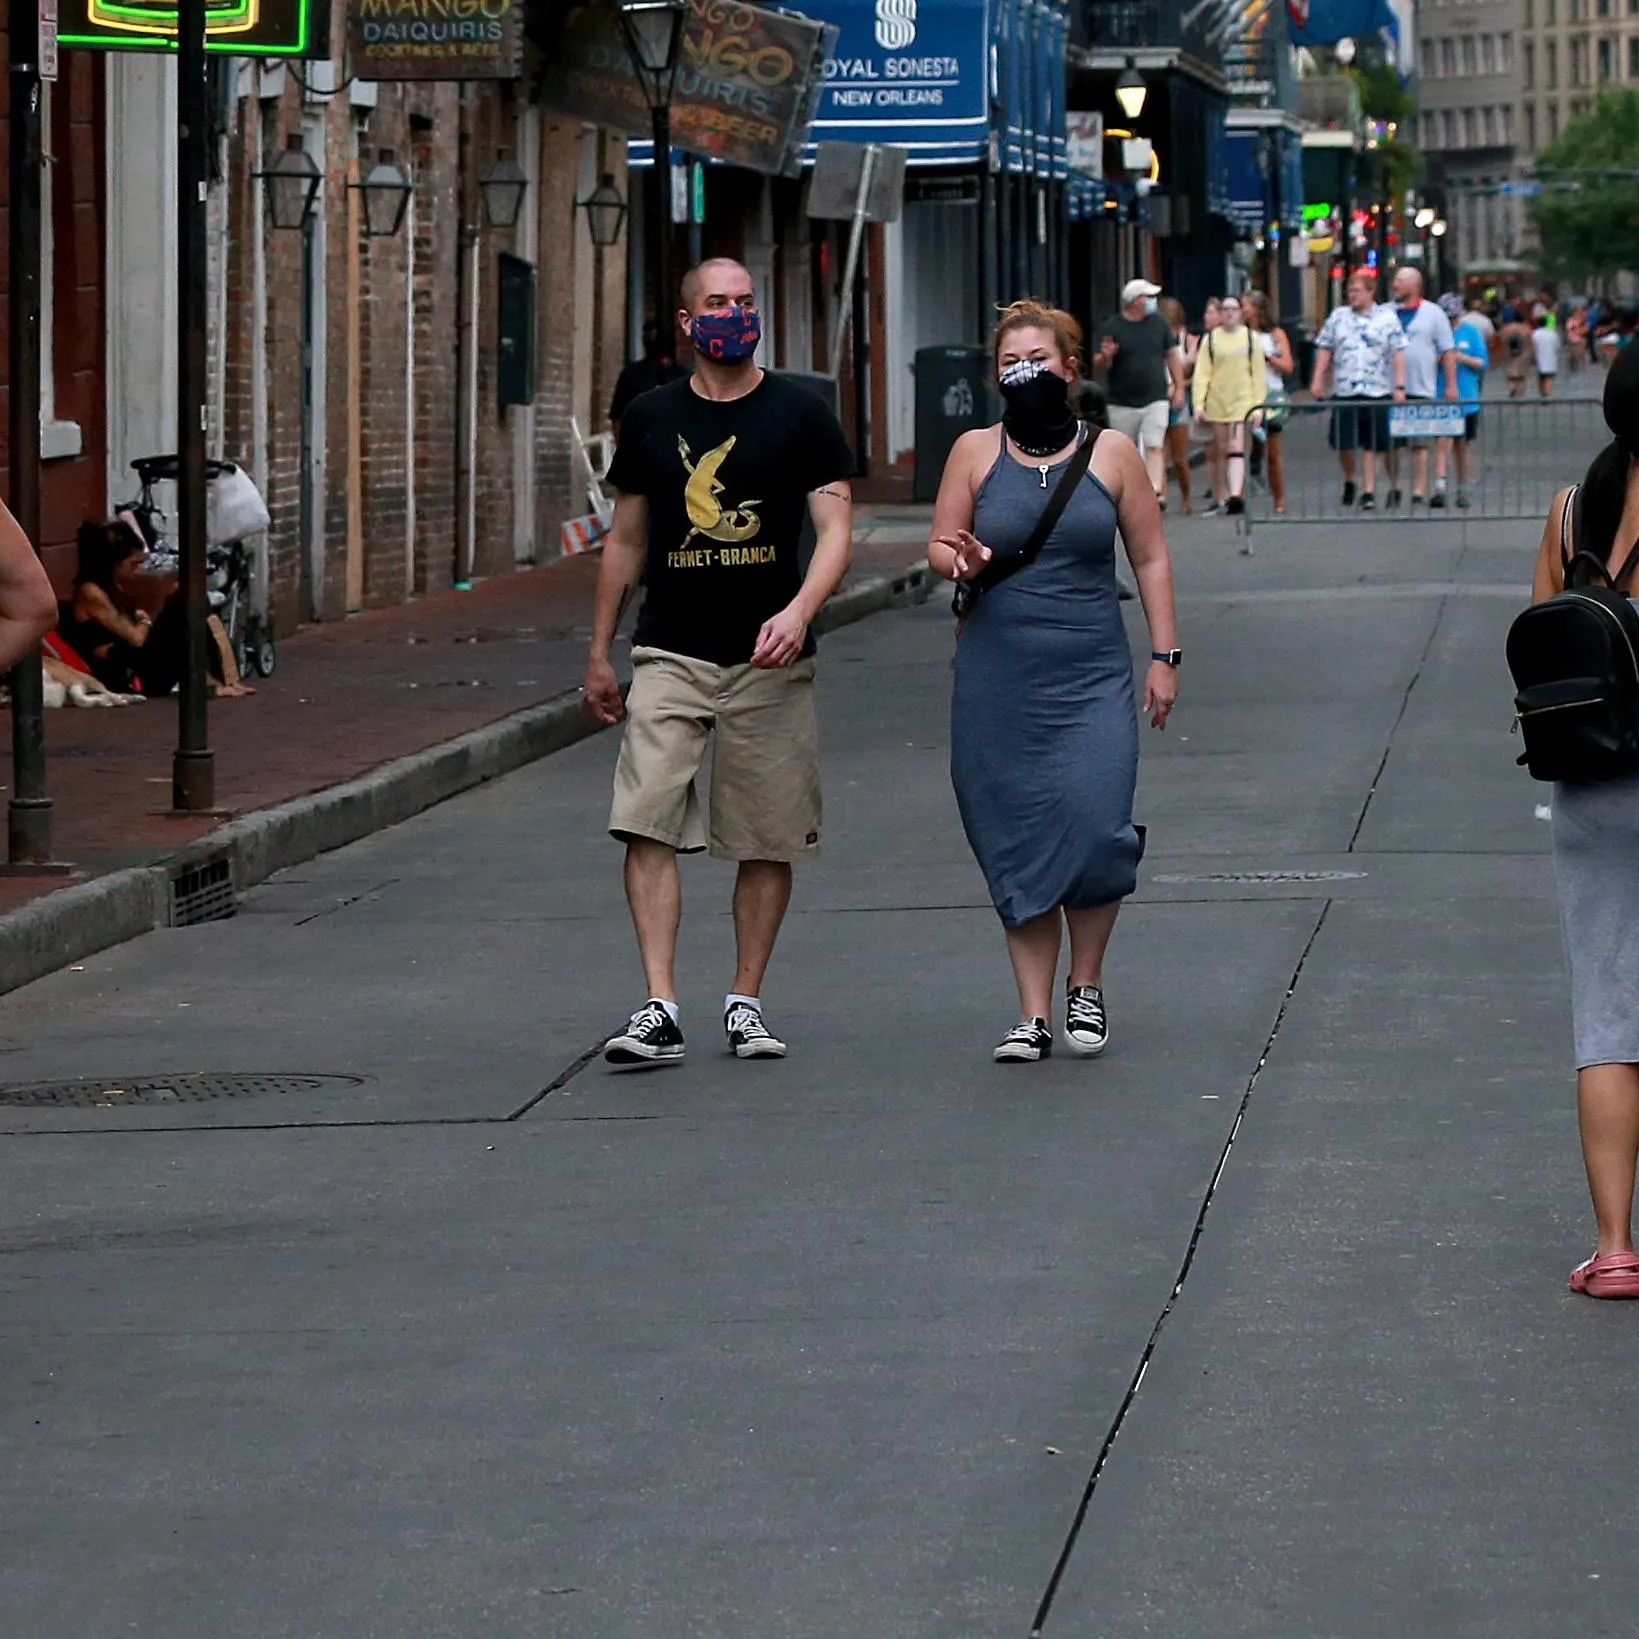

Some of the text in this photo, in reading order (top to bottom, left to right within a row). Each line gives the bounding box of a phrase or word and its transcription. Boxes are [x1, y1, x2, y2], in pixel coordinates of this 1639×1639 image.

[363, 21, 503, 43] DAIQUIRIS
[682, 29, 793, 87] NGO
[822, 56, 959, 78] OYAL SONESTA
[833, 88, 944, 106] NEW ORLEANS
